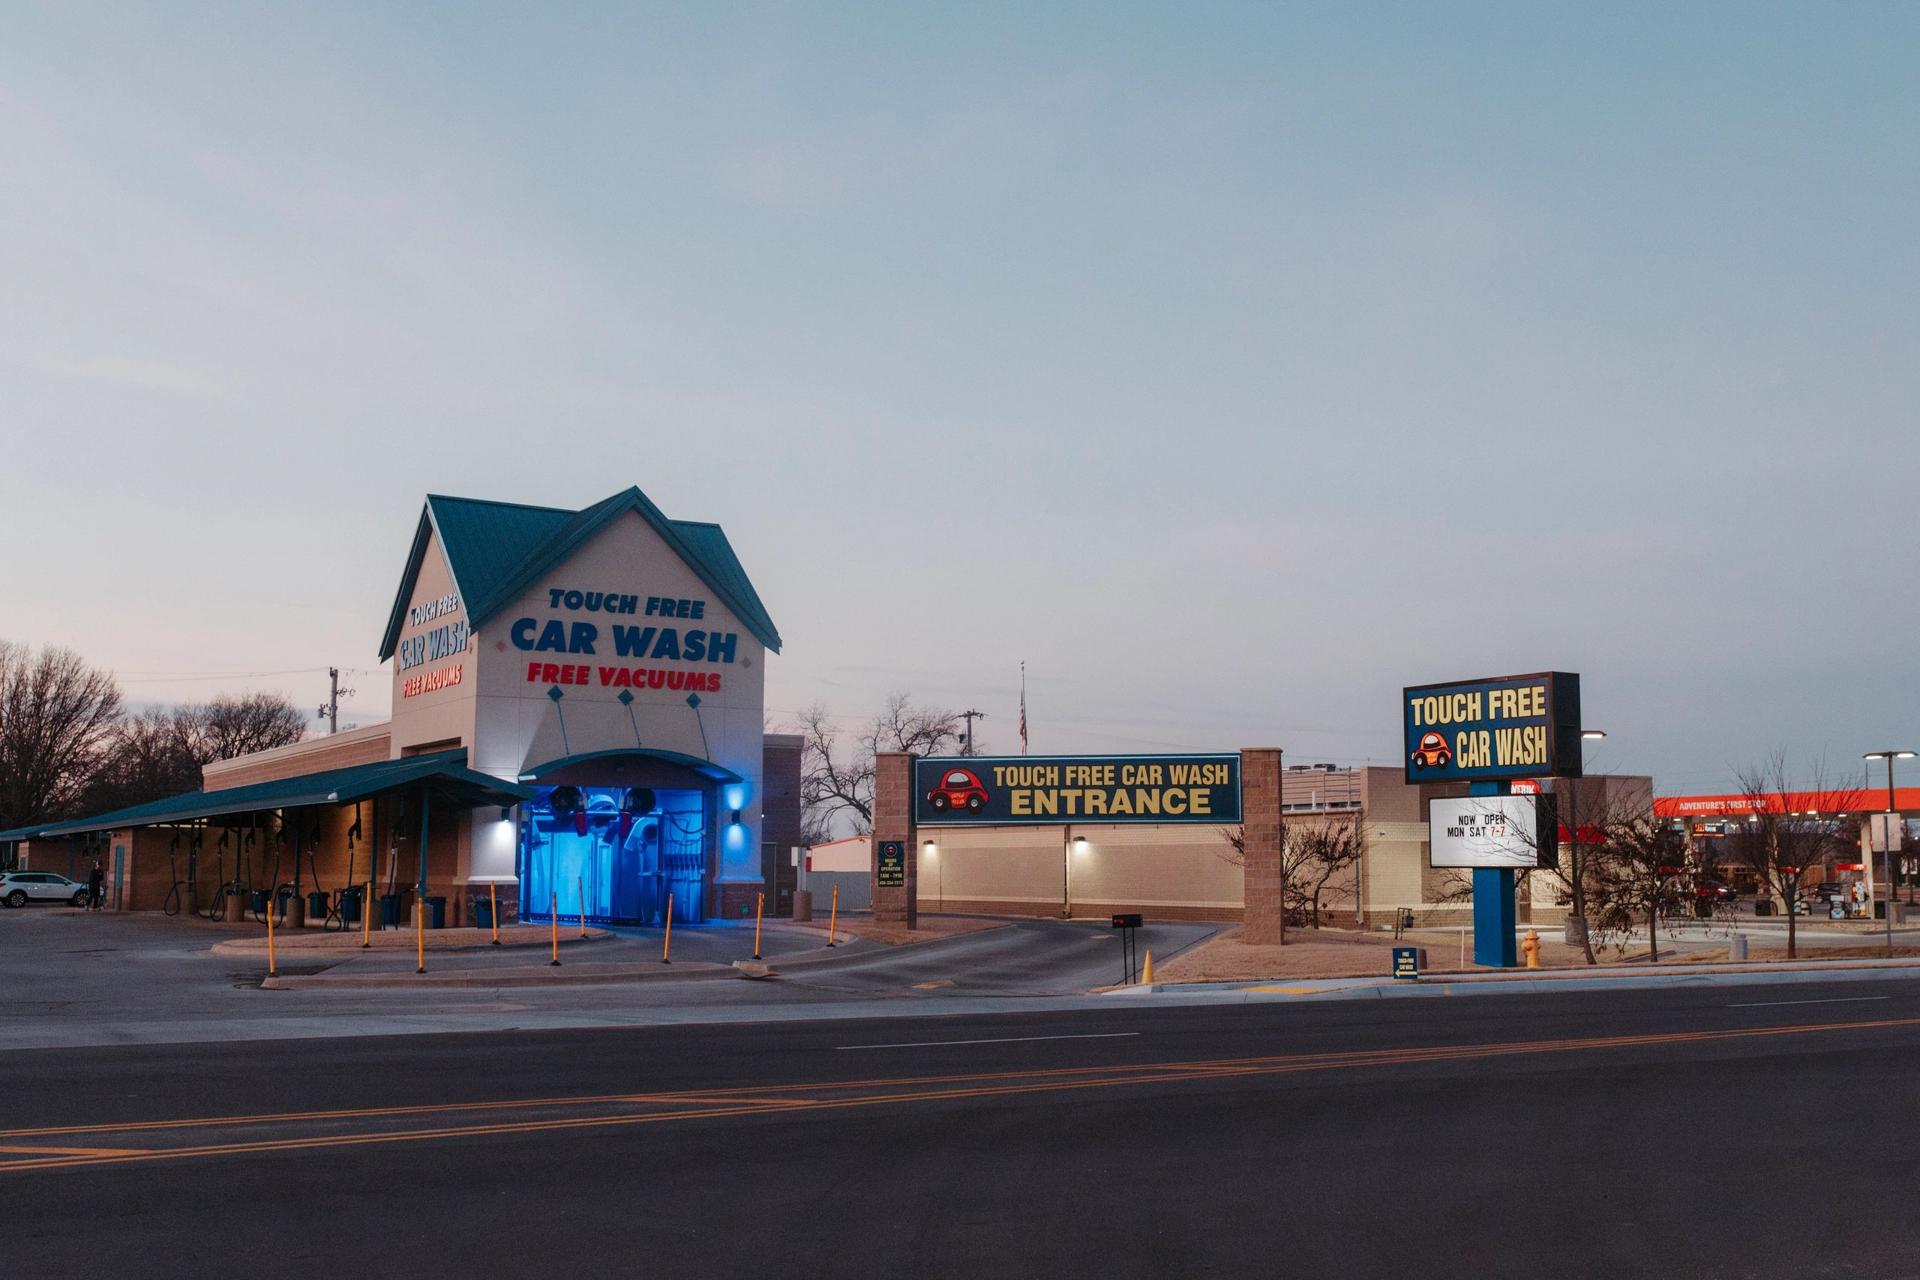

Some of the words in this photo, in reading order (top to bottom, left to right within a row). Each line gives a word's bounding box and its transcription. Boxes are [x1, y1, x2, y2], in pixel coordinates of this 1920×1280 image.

[411, 600, 438, 627] TOUCH
[438, 592, 459, 618] FREE
[549, 588, 638, 615] TOUCH
[645, 596, 706, 620] FREE
[400, 635, 425, 671] CAR
[428, 620, 468, 662] WASH
[510, 617, 598, 655] CAR
[612, 624, 737, 664] WASH
[404, 676, 422, 699] FREE
[423, 664, 463, 693] VACUUMS
[527, 662, 590, 686] FREE
[598, 667, 722, 693] VACUUMS
[1411, 691, 1482, 727] TOUCH
[1488, 685, 1546, 720] FREE
[1456, 730, 1491, 769] CAR
[1495, 726, 1547, 766] WASH
[993, 765, 1058, 787] TOUCH
[1066, 765, 1115, 786] FREE
[1122, 764, 1162, 786] CAR
[1169, 764, 1229, 786] WASH
[1011, 788, 1211, 815] ENTRANCE
[1680, 800, 1726, 810] ADVENTURE'S
[1448, 827, 1464, 837] MON
[1470, 826, 1487, 837] SAT
[1491, 827, 1505, 837] 7-7
[1458, 815, 1475, 825] NOW
[1484, 814, 1505, 825] OPEN
